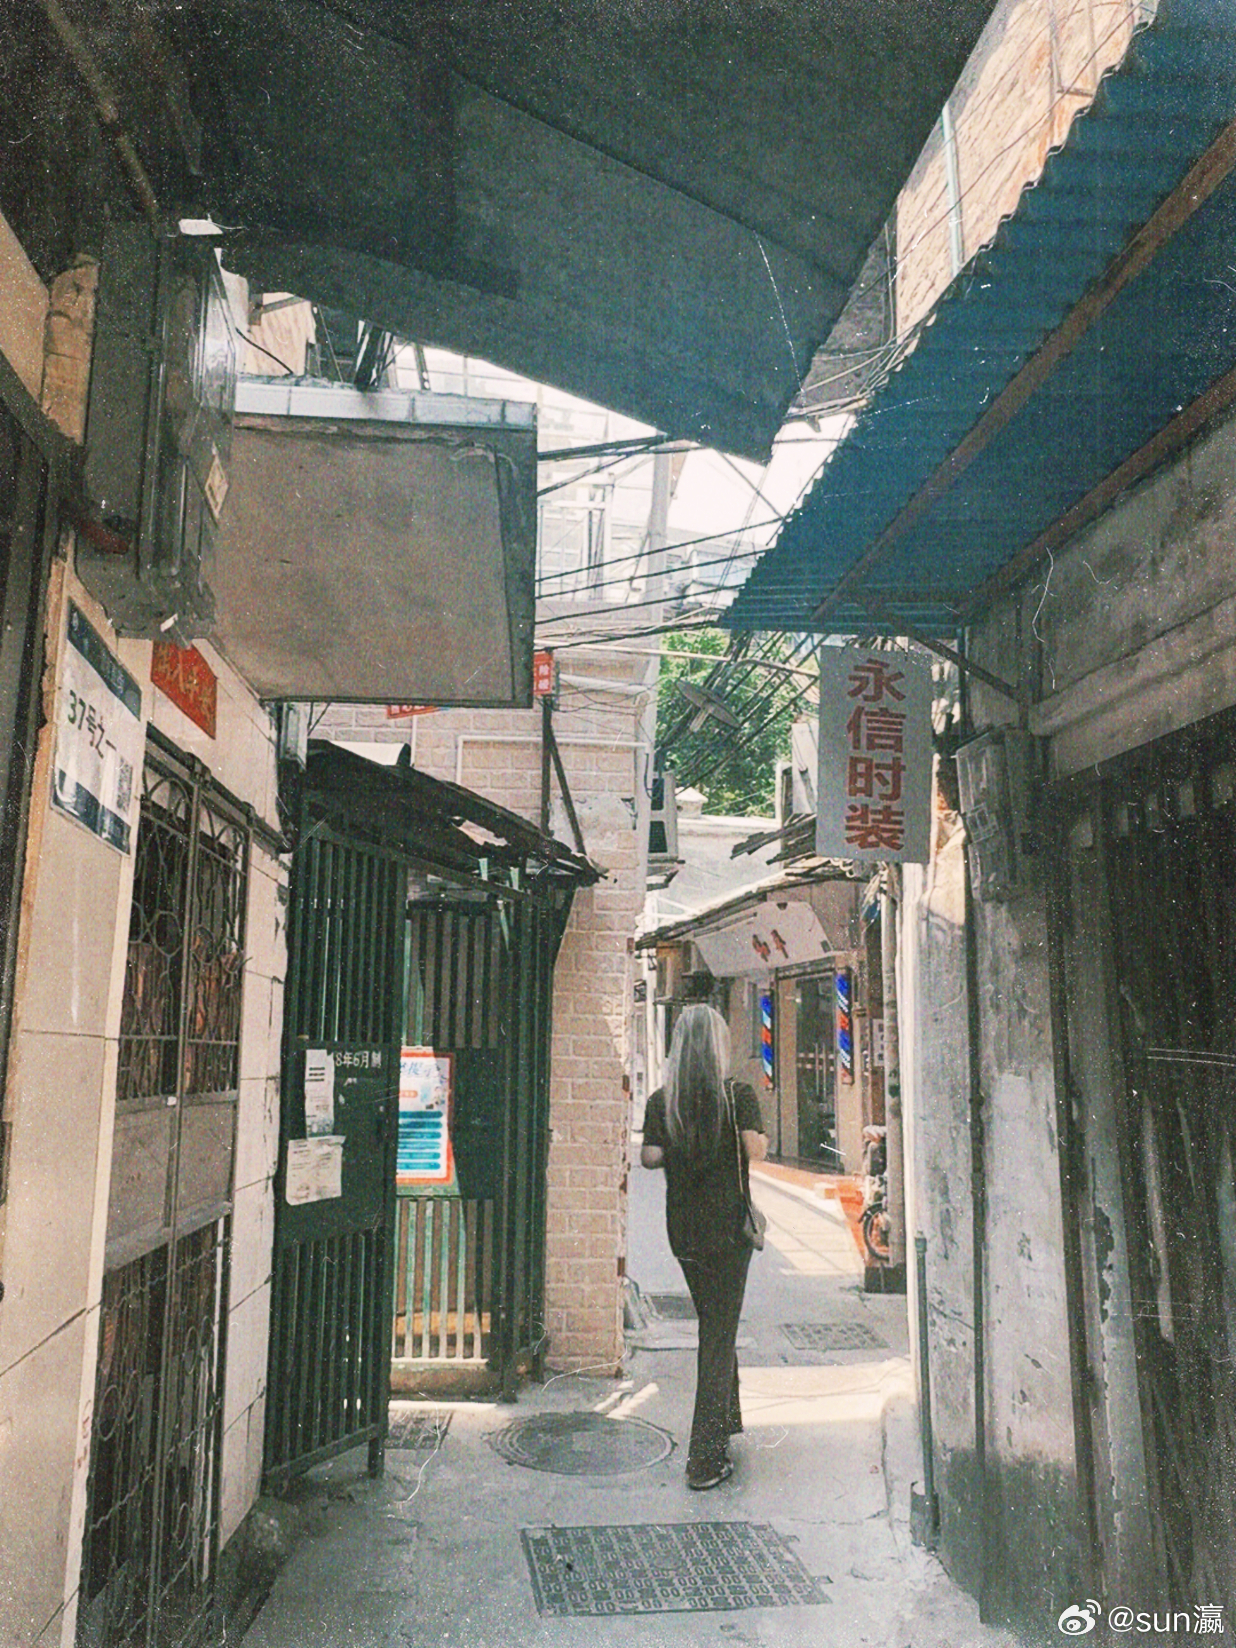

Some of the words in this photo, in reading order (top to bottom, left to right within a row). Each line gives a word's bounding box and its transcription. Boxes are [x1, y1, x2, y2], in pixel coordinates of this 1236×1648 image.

[68, 690, 117, 759] 37号之一
[845, 658, 906, 851] 永信时装
